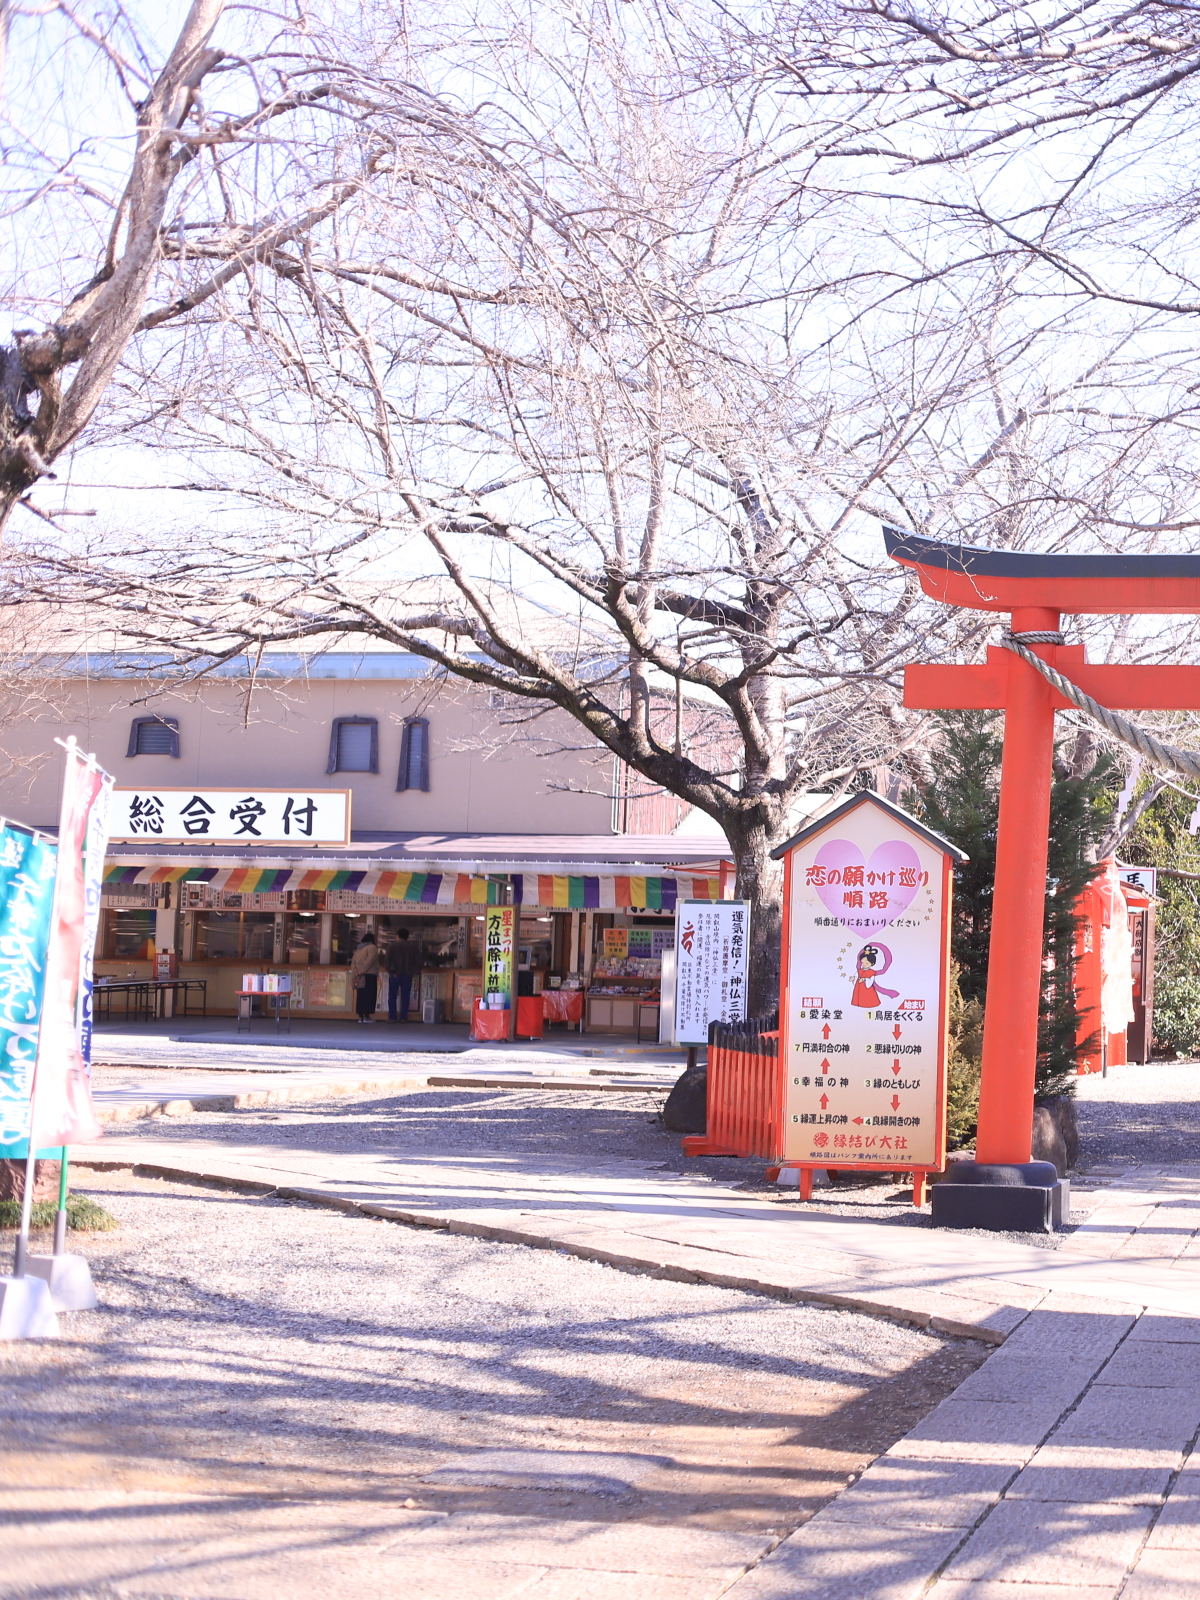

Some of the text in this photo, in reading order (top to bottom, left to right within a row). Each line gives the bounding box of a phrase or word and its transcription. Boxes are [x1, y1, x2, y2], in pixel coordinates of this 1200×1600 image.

[128, 794, 319, 837] 総合受付
[805, 864, 929, 887] 恋の願かけ巡り
[842, 890, 889, 909] 順路
[813, 916, 921, 928] 順番通りにおまいりください
[501, 910, 513, 957] 星まつり
[903, 1000, 925, 1010] 始まり
[800, 1009, 843, 1020] 8 愛染堂
[867, 1011, 923, 1022] 1 鳥居をくぐる
[795, 1042, 850, 1054] 7 円満和合の神
[866, 1043, 922, 1055] 2 悪縁切りの神
[793, 1076, 849, 1088] 6 幸福の神
[865, 1078, 921, 1090] 3 縁のともしび
[792, 1113, 849, 1125] 5 縁運上昇の神
[865, 1115, 920, 1127] 4 良縁開きの神
[833, 1133, 908, 1150] 縁結び大社
